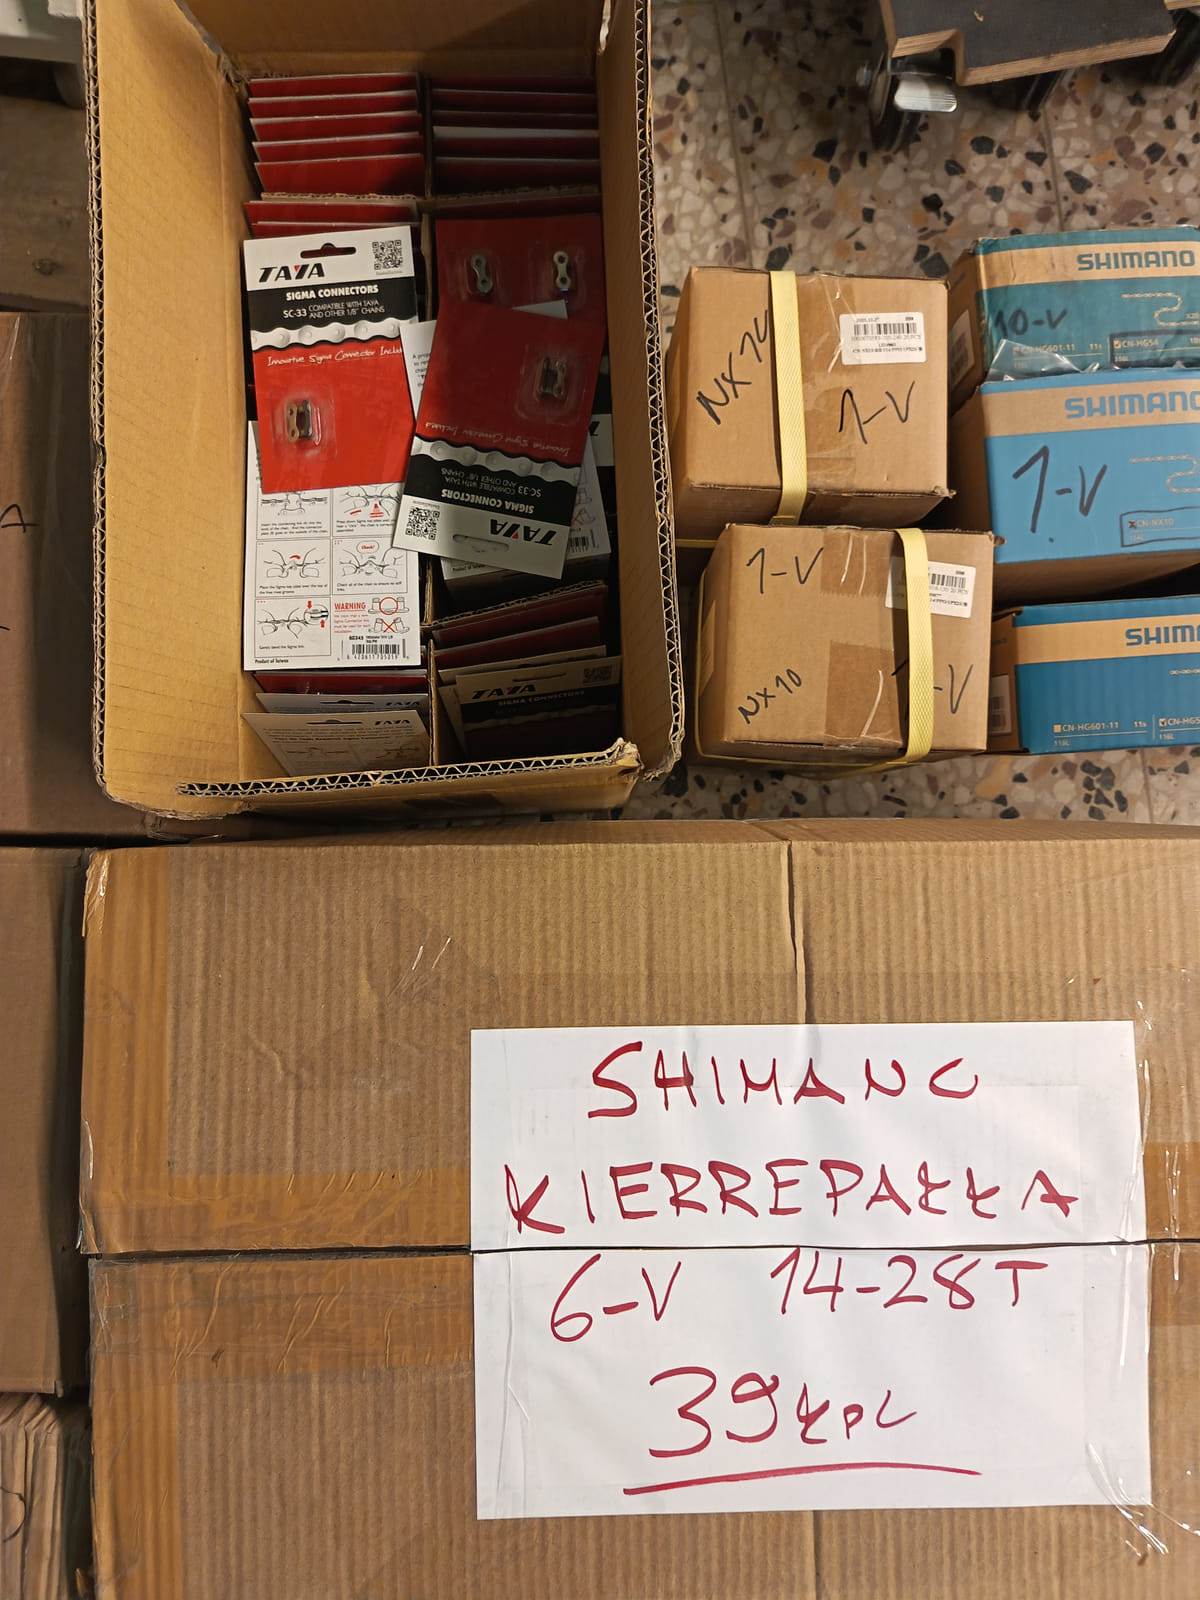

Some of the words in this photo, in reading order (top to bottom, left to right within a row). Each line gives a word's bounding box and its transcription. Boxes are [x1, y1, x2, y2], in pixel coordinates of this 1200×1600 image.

[1077, 250, 1196, 271] SHIMANO
[258, 262, 325, 283] TAYA
[286, 290, 316, 301] SIGMA
[318, 284, 379, 299] CONNECTORS
[283, 309, 307, 319] SC-33
[308, 303, 345, 312] COMPATIBLE
[309, 311, 324, 319] AND
[324, 309, 345, 318] OTHER
[361, 306, 386, 315] CHAINS
[994, 308, 1068, 339] 10-V
[334, 349, 375, 362] Connector
[440, 467, 465, 479] CHAINS
[440, 487, 502, 509] CONNECTORS
[518, 485, 542, 498] SC-33
[504, 499, 535, 514] SIGMA
[488, 518, 558, 547] TAYA
[334, 602, 366, 610] WARNING
[1125, 625, 1200, 646] SHIM
[472, 684, 537, 700] TAYA
[1062, 722, 1119, 732] CN-HG601-11
[550, 1253, 683, 1343] 6-V
